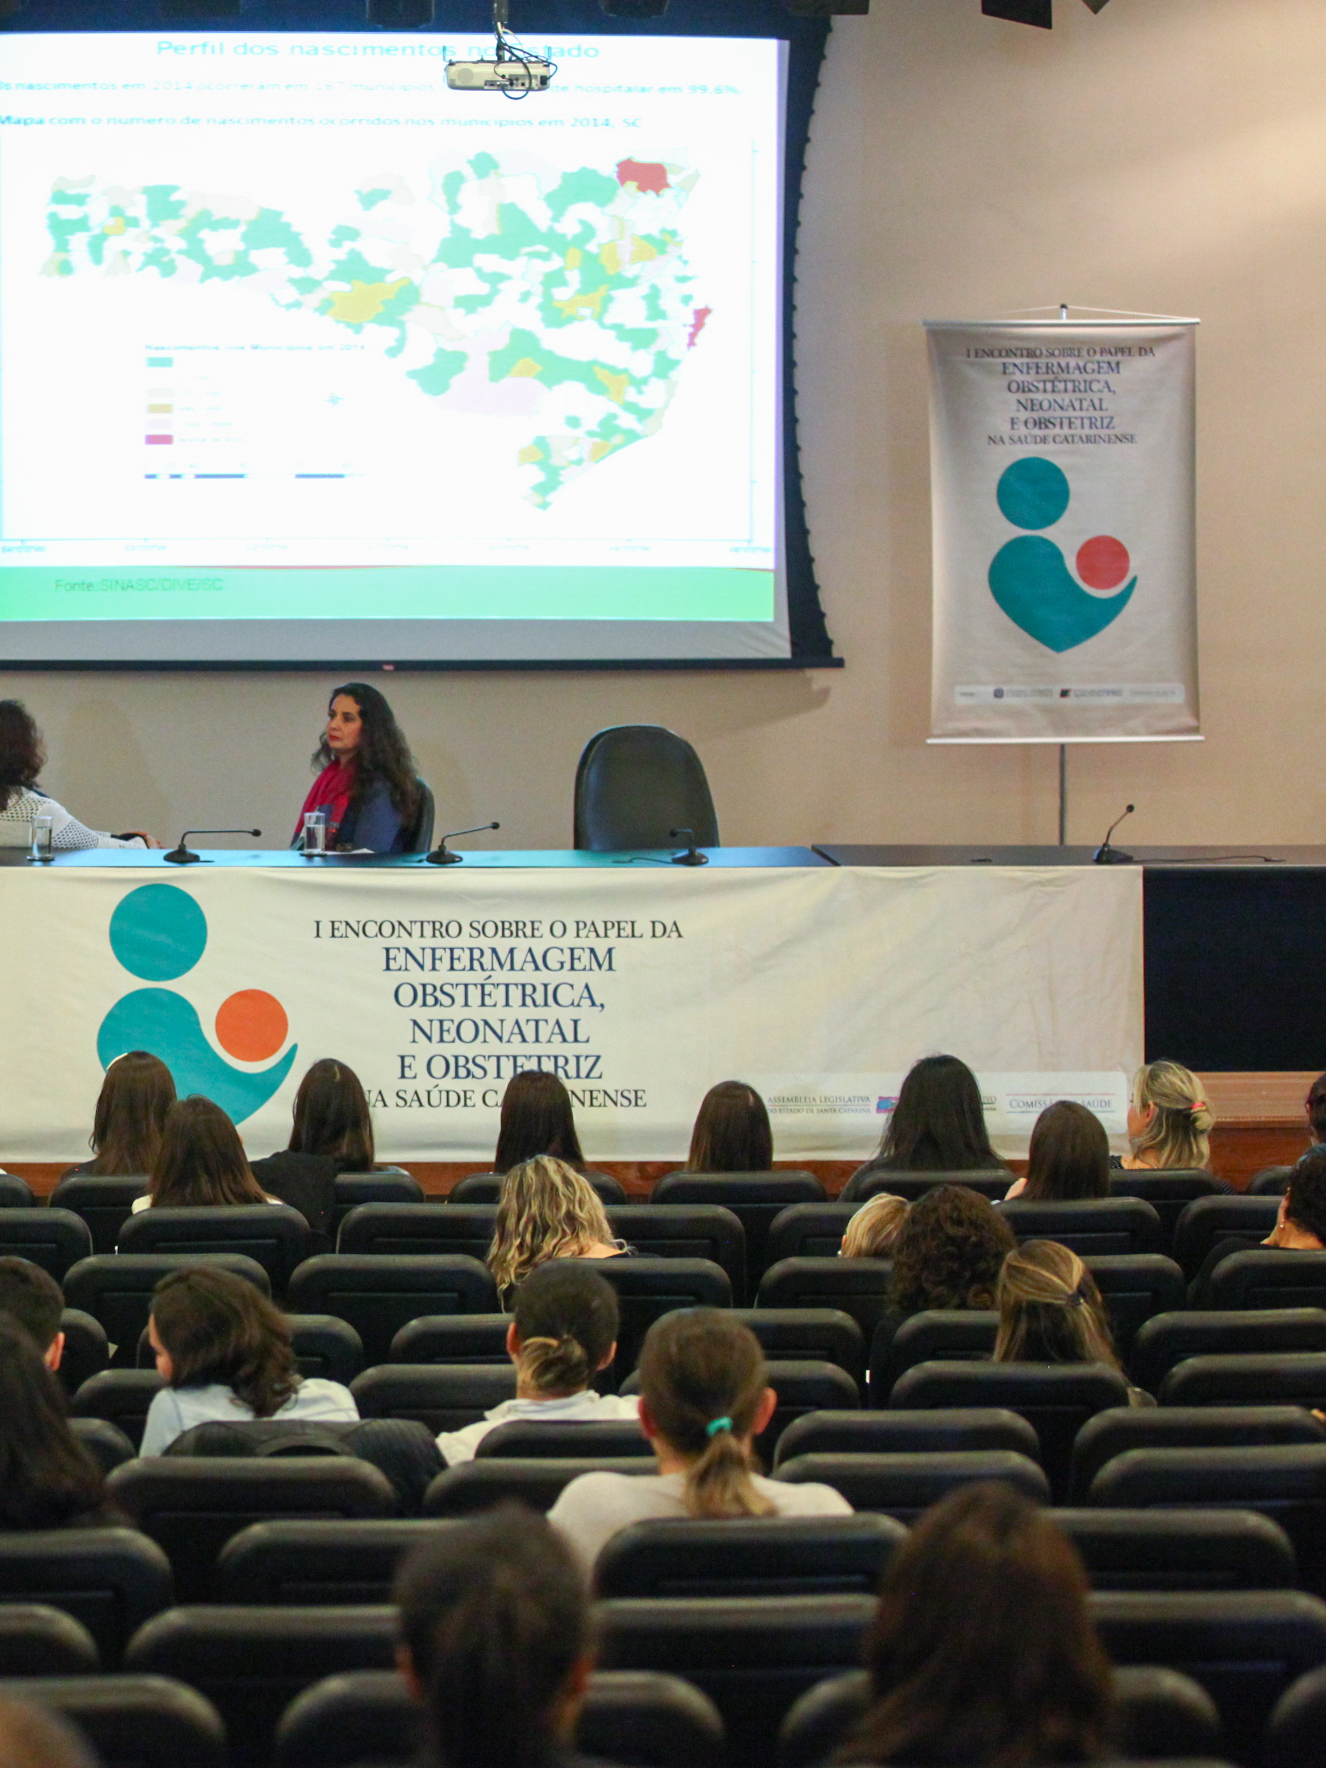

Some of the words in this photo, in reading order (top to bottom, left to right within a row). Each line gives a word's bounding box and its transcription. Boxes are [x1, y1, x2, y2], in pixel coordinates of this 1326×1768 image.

[156, 40, 224, 56] Perfil
[232, 41, 280, 56] dos
[290, 43, 457, 57] nascimentos
[15, 81, 118, 91] nascimentos
[121, 82, 146, 91] em
[657, 85, 683, 94] em
[48, 116, 87, 126] com
[90, 116, 103, 126] o
[179, 115, 202, 126] de
[206, 115, 315, 126] nascimentos
[319, 115, 401, 127] ocorridos
[405, 117, 436, 127] nos
[537, 117, 566, 127] em
[622, 117, 642, 128] SC
[974, 347, 1044, 358] ENCONTRO
[1045, 346, 1084, 358] SOBRE
[1086, 347, 1097, 358] O
[1099, 346, 1136, 358] PAPEL
[1138, 346, 1156, 358] DA
[1001, 360, 1122, 376] ENFERMAGEM
[1007, 376, 1117, 394] OBSTÉTRICA,
[1016, 398, 1109, 412] NEONATAL
[1009, 416, 1020, 430] E
[1024, 416, 1116, 431] OBSTETRIZ
[987, 434, 1005, 446] NA
[1008, 432, 1051, 446] SAÚDE
[1052, 433, 1138, 446] CATARINENSE
[314, 920, 323, 939] I
[329, 919, 463, 939] ENCONTRO
[469, 919, 544, 939] SOBRE
[550, 919, 568, 939] O
[573, 919, 644, 939] PAPEL
[650, 919, 684, 939] DA
[382, 946, 616, 972] ENFERMAGEM
[393, 974, 606, 1012] OBSTÉTRICA,
[409, 1018, 590, 1044] NEONATAL
[397, 1054, 417, 1080] E
[426, 1053, 603, 1081] OBSTETRIZ
[395, 1084, 476, 1108] SAÚDE
[767, 1095, 815, 1104] ASSEMBLEIA
[819, 1095, 871, 1104] LEGISLATIVA
